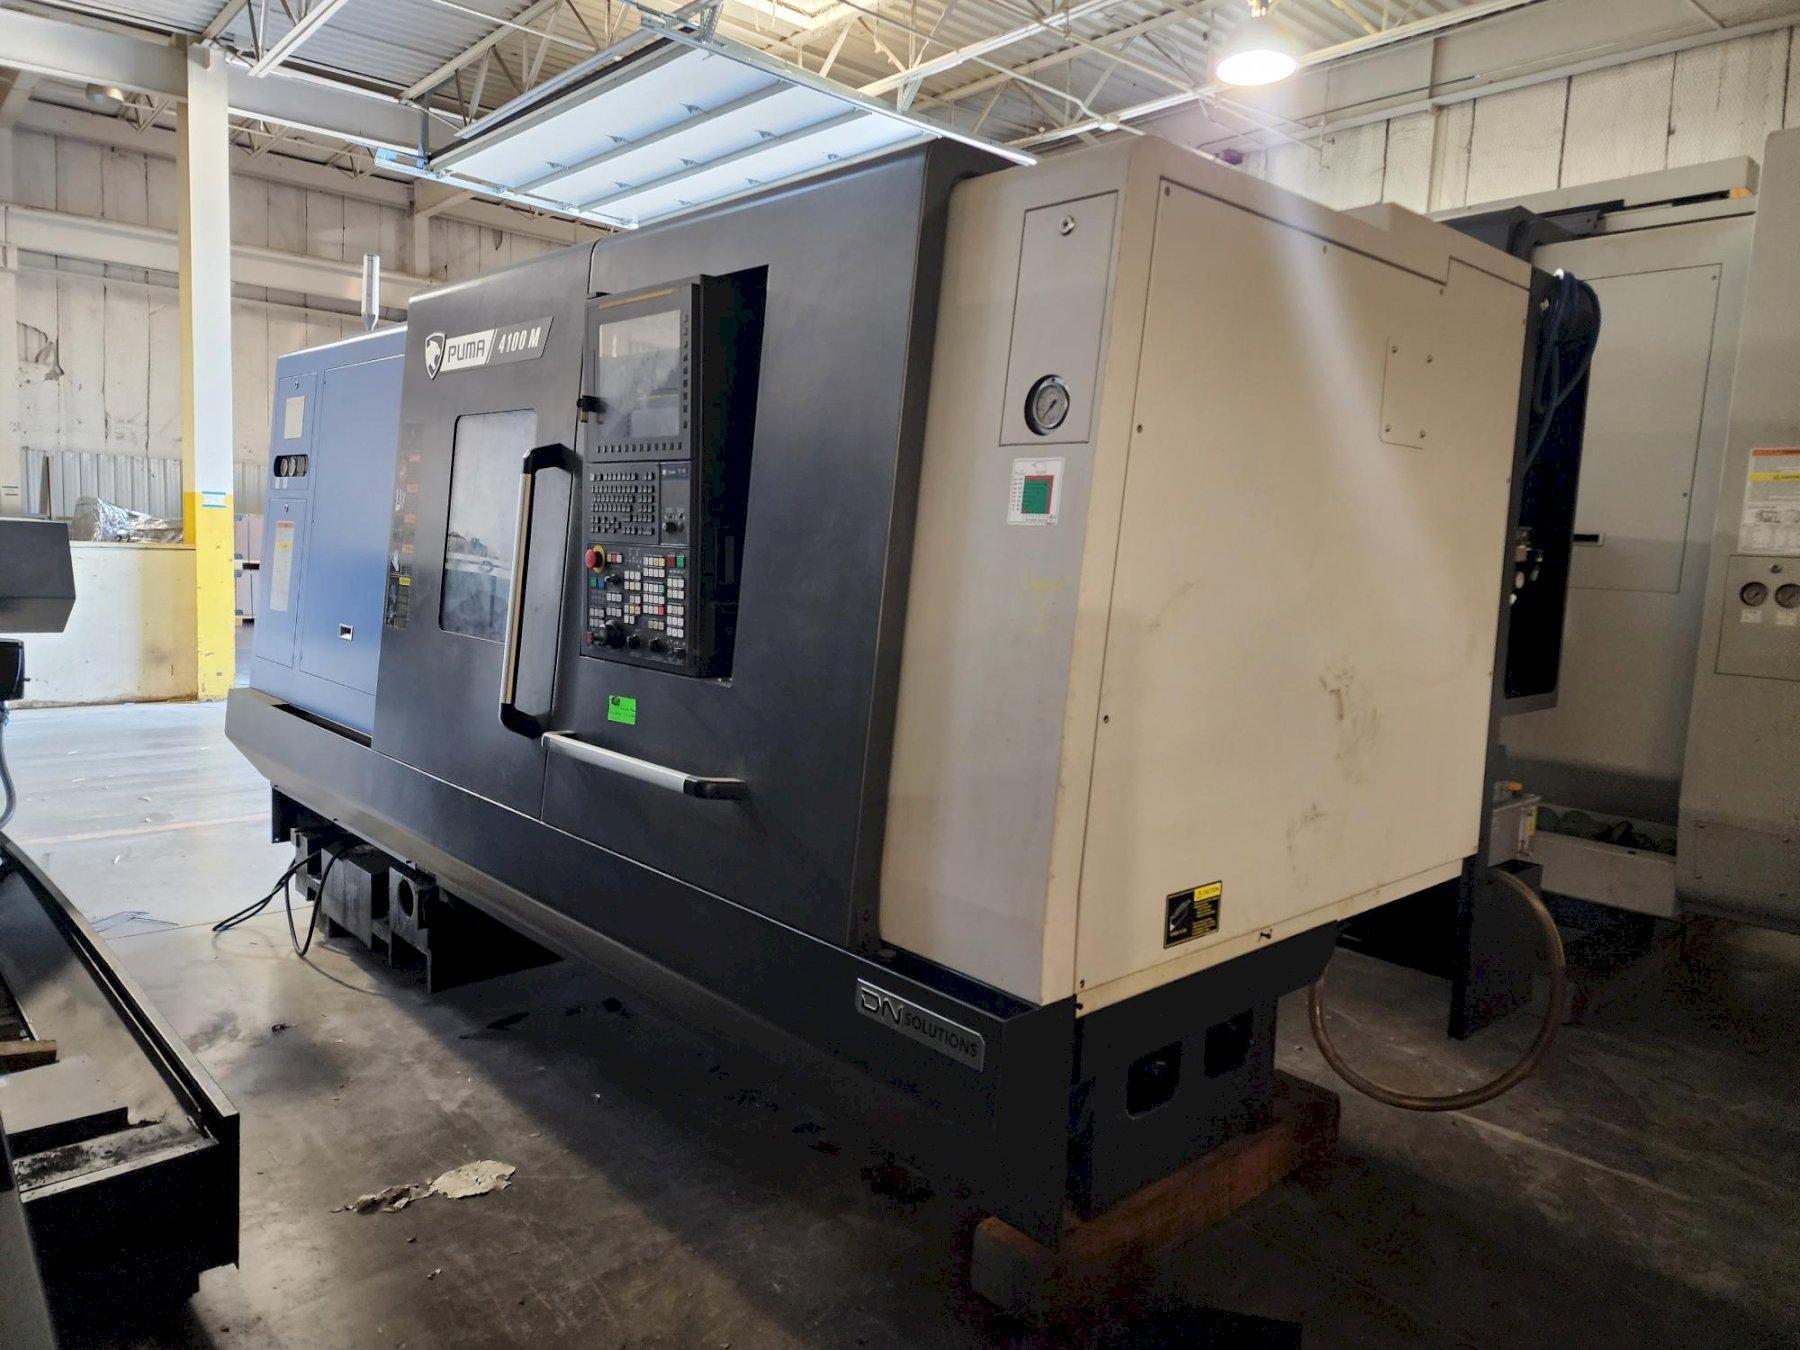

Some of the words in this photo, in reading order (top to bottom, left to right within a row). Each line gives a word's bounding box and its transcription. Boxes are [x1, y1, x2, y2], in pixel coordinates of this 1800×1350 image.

[447, 339, 485, 362] PUMA
[498, 330, 527, 354] 4100
[528, 326, 541, 349] M
[861, 986, 904, 1025] DN
[905, 1012, 977, 1058] SOLUTIONS
